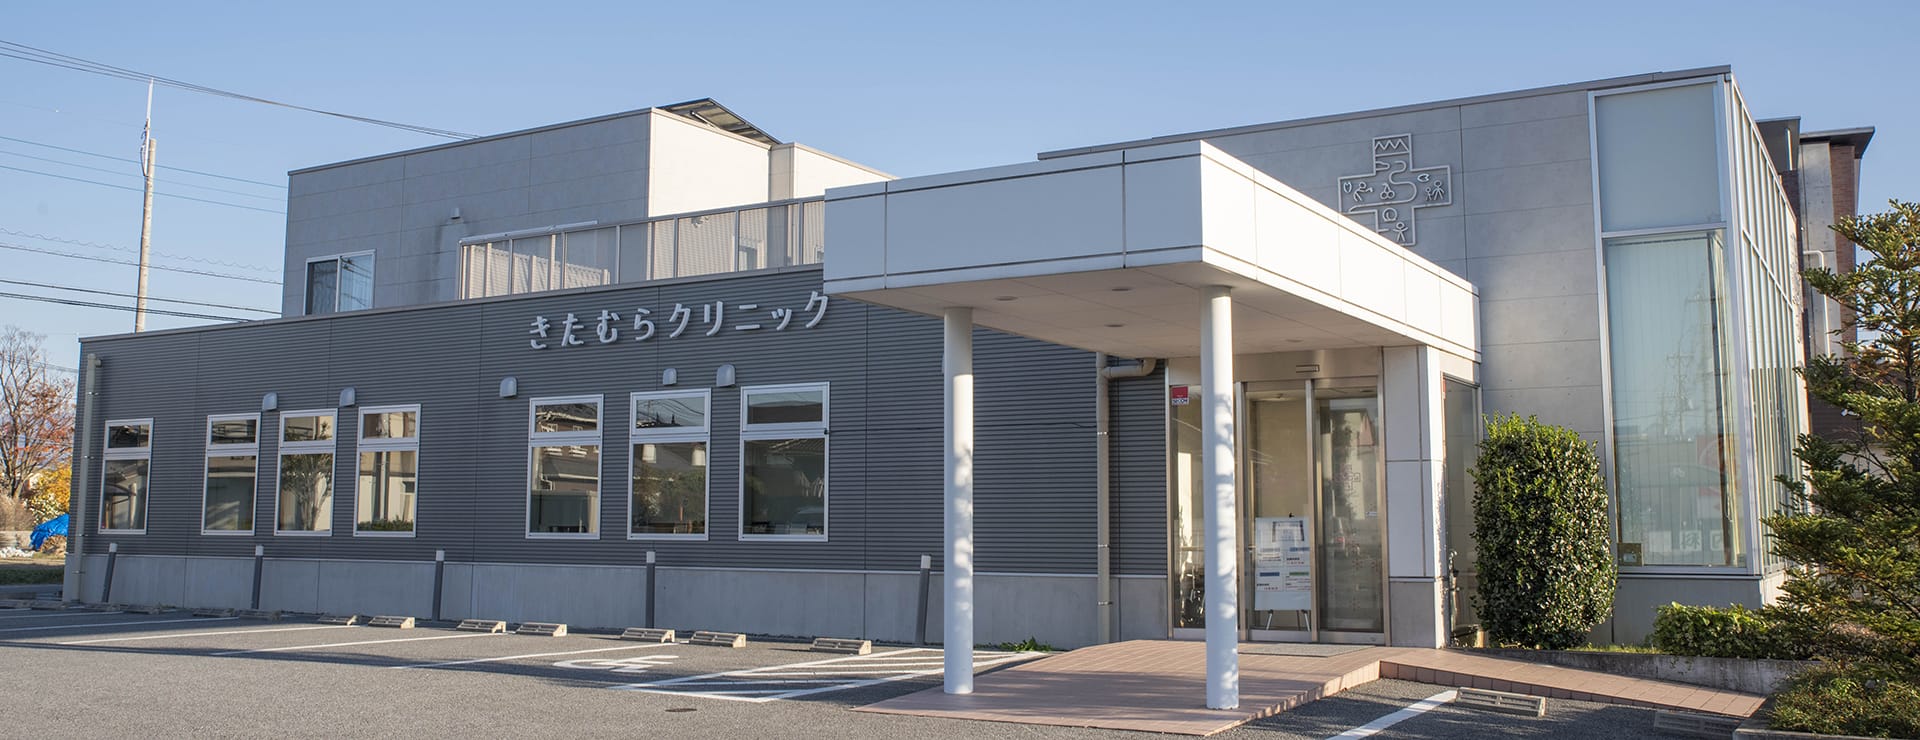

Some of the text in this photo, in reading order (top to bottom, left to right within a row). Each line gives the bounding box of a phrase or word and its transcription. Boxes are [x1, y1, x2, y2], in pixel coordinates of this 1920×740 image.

[529, 291, 828, 349] きたむらクリニック
